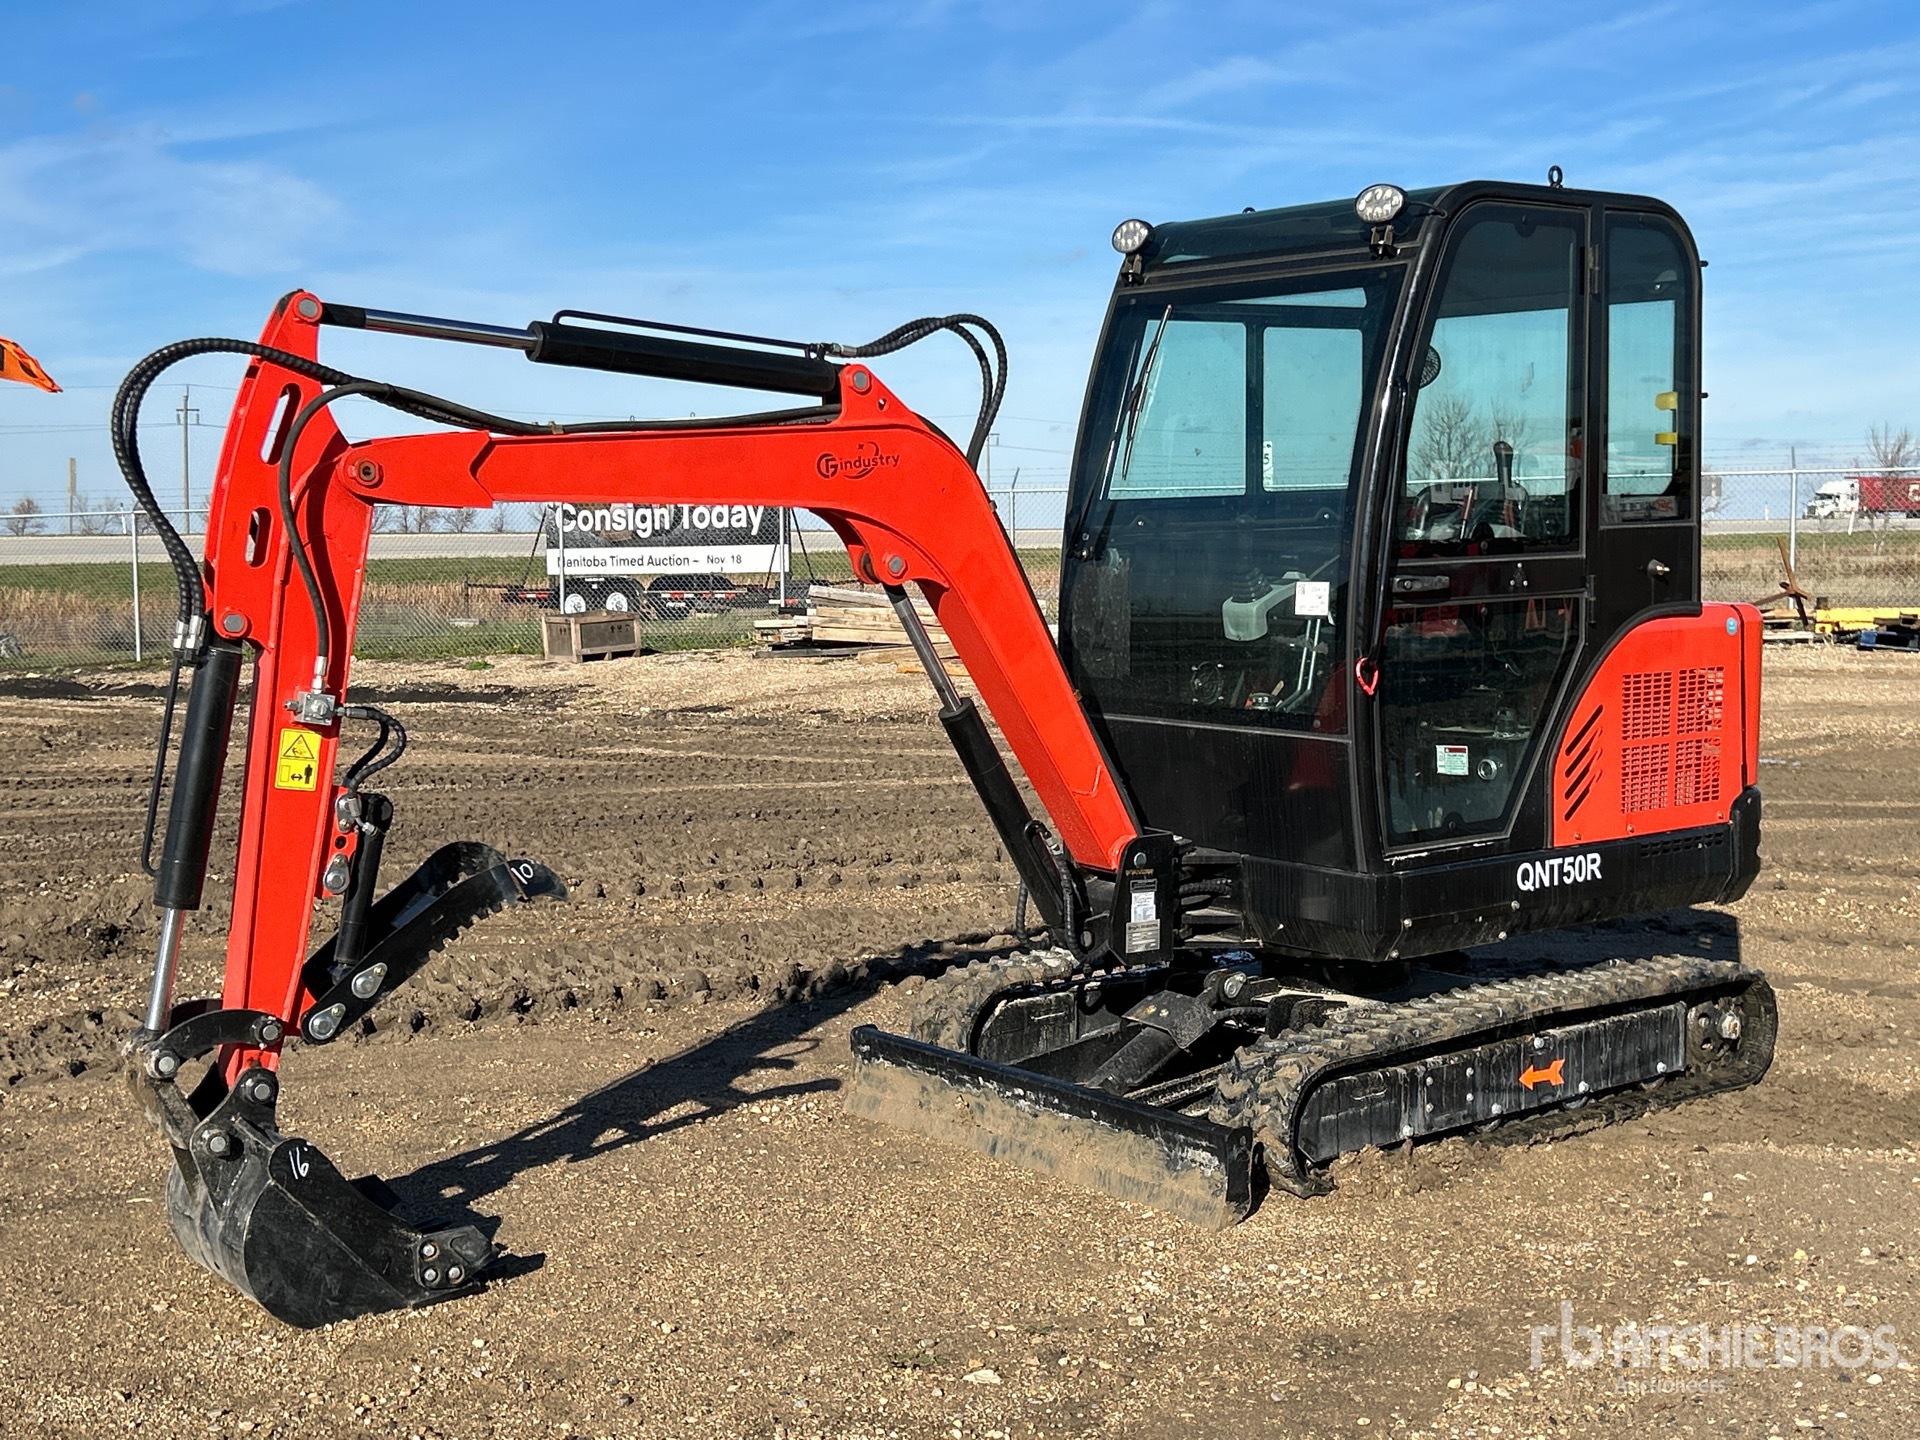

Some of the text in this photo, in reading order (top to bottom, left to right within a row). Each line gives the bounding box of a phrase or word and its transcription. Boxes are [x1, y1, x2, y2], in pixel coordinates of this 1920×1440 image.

[555, 503, 765, 538] Consign Today
[609, 555, 645, 567] Timed
[647, 553, 690, 568] Auction
[731, 554, 742, 564] 18
[510, 863, 534, 885] 10
[1516, 852, 1602, 892] QNT50R
